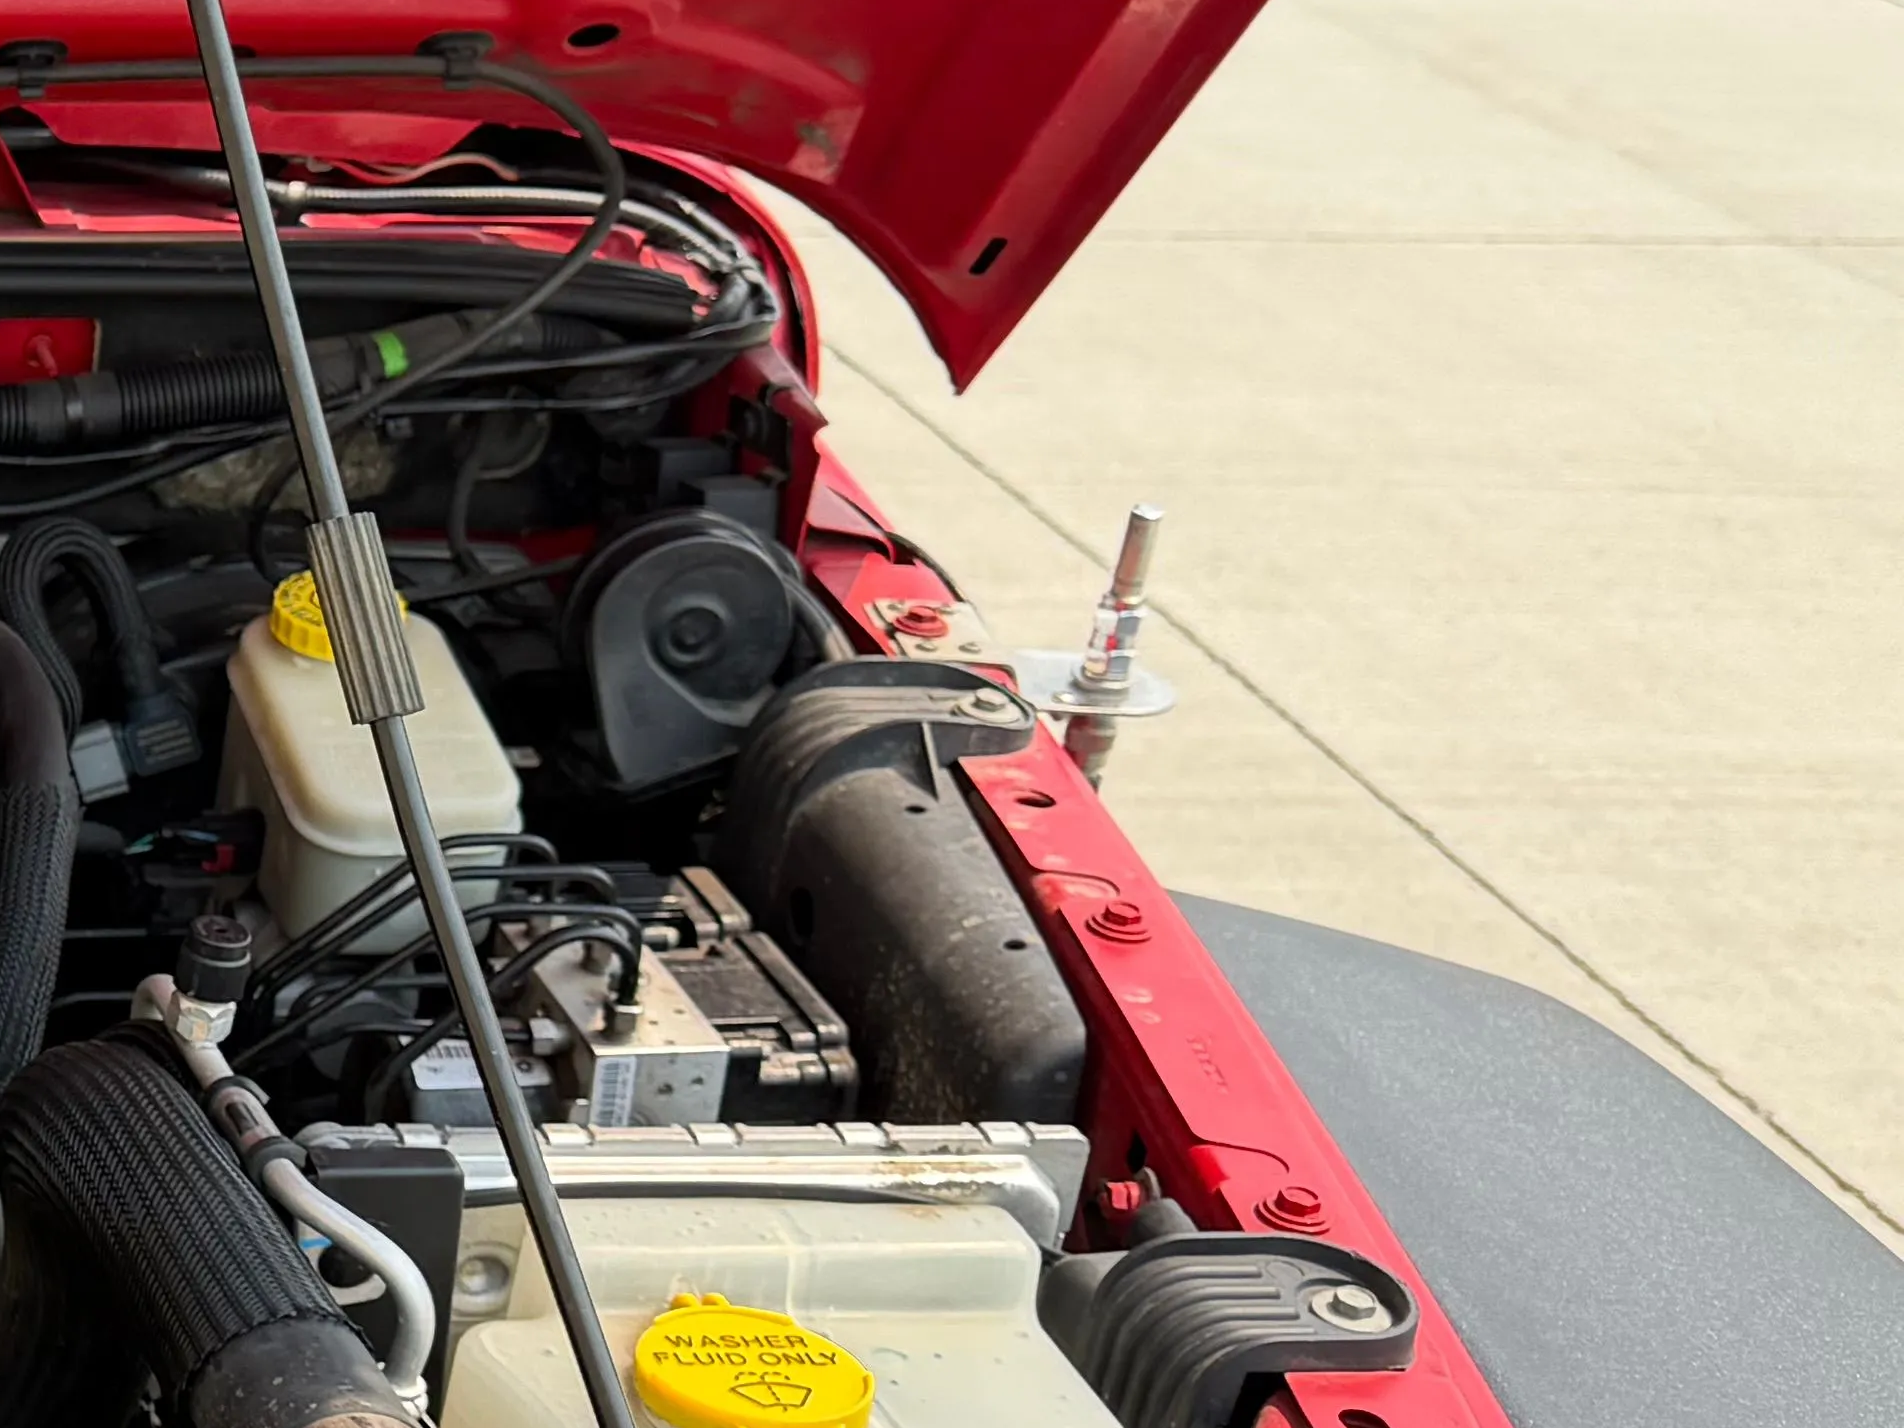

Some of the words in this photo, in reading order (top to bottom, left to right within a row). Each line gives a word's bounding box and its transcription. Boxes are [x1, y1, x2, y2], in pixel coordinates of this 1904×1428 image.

[663, 1334, 808, 1349] WASHER
[652, 1351, 747, 1367] FLUID
[759, 1351, 838, 1367] ONLY
